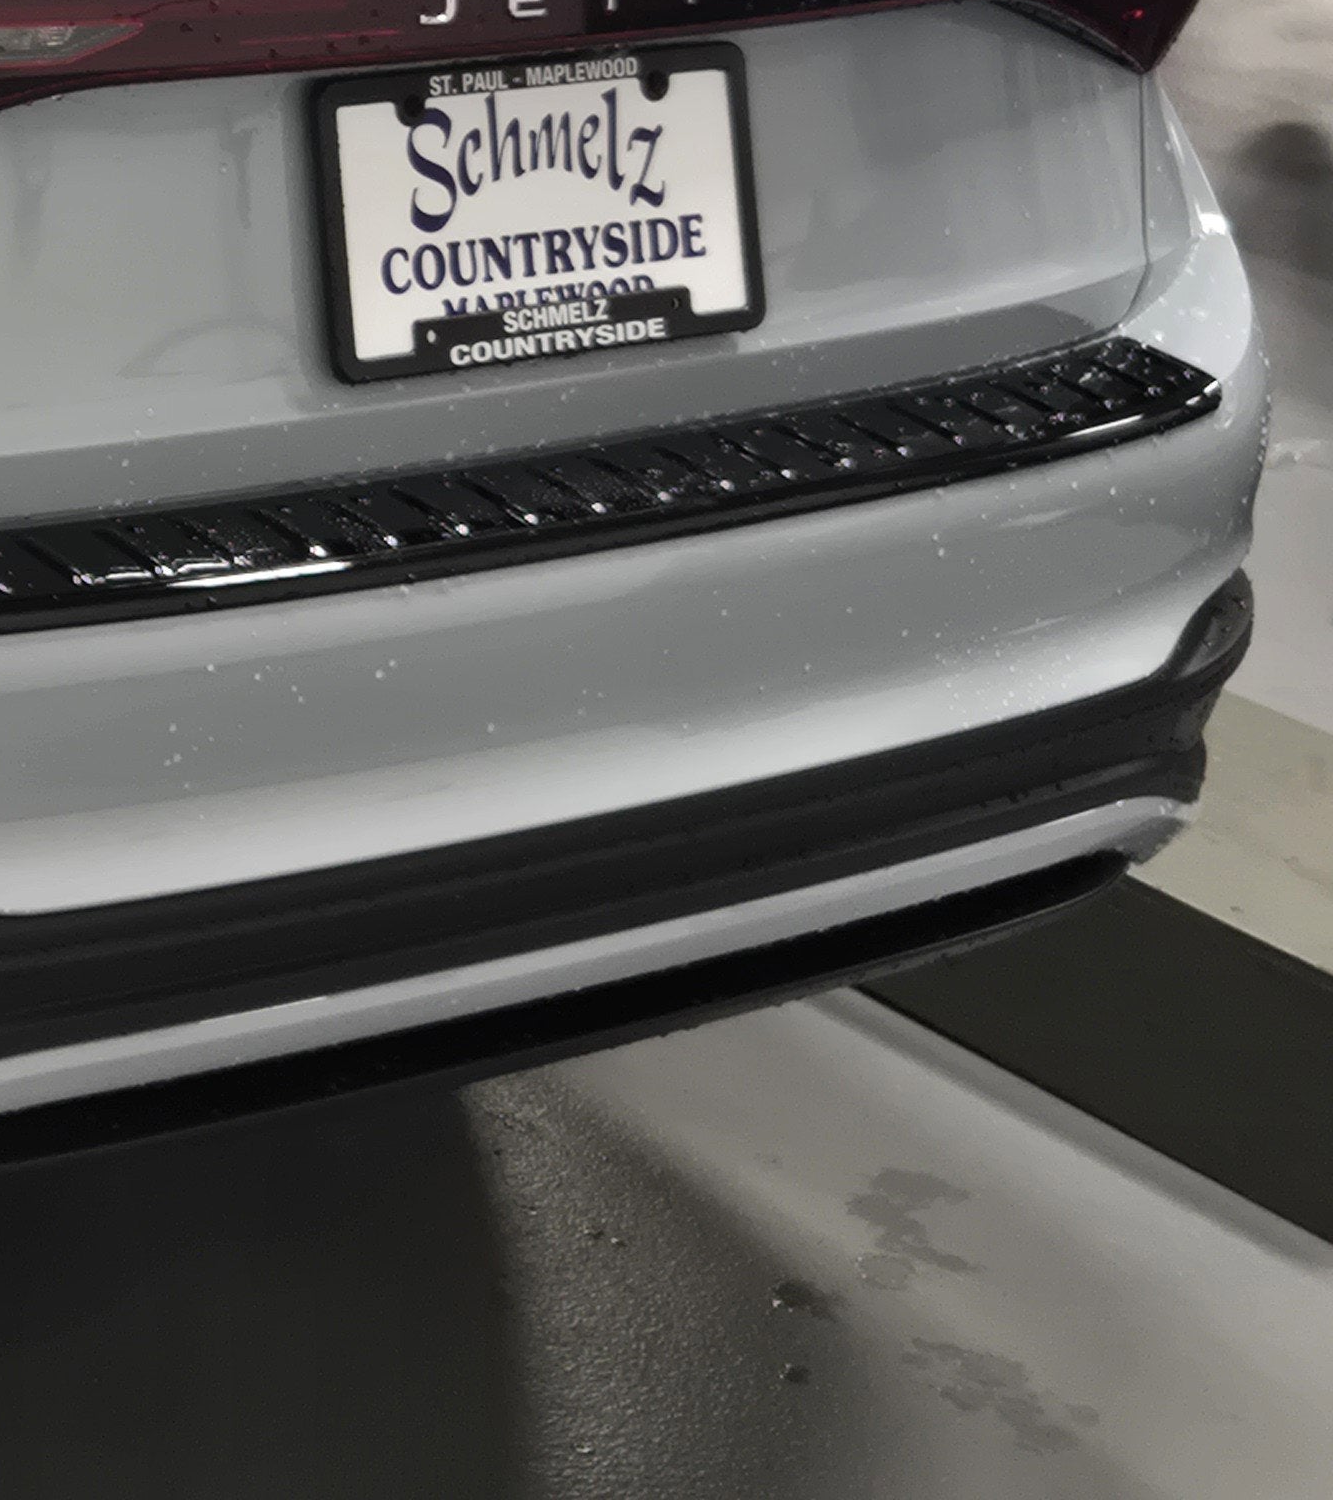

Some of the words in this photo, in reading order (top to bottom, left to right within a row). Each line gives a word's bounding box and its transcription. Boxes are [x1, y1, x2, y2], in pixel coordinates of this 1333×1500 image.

[428, 75, 458, 96] ST.
[462, 70, 509, 92] PAUL
[525, 56, 639, 87] MAPLEWOOD
[406, 87, 666, 233] Schmelz
[380, 213, 708, 295] COUNTRYSIDE
[449, 316, 667, 367] COUNTRYSIDE
[502, 298, 609, 334] SCHMELZ
